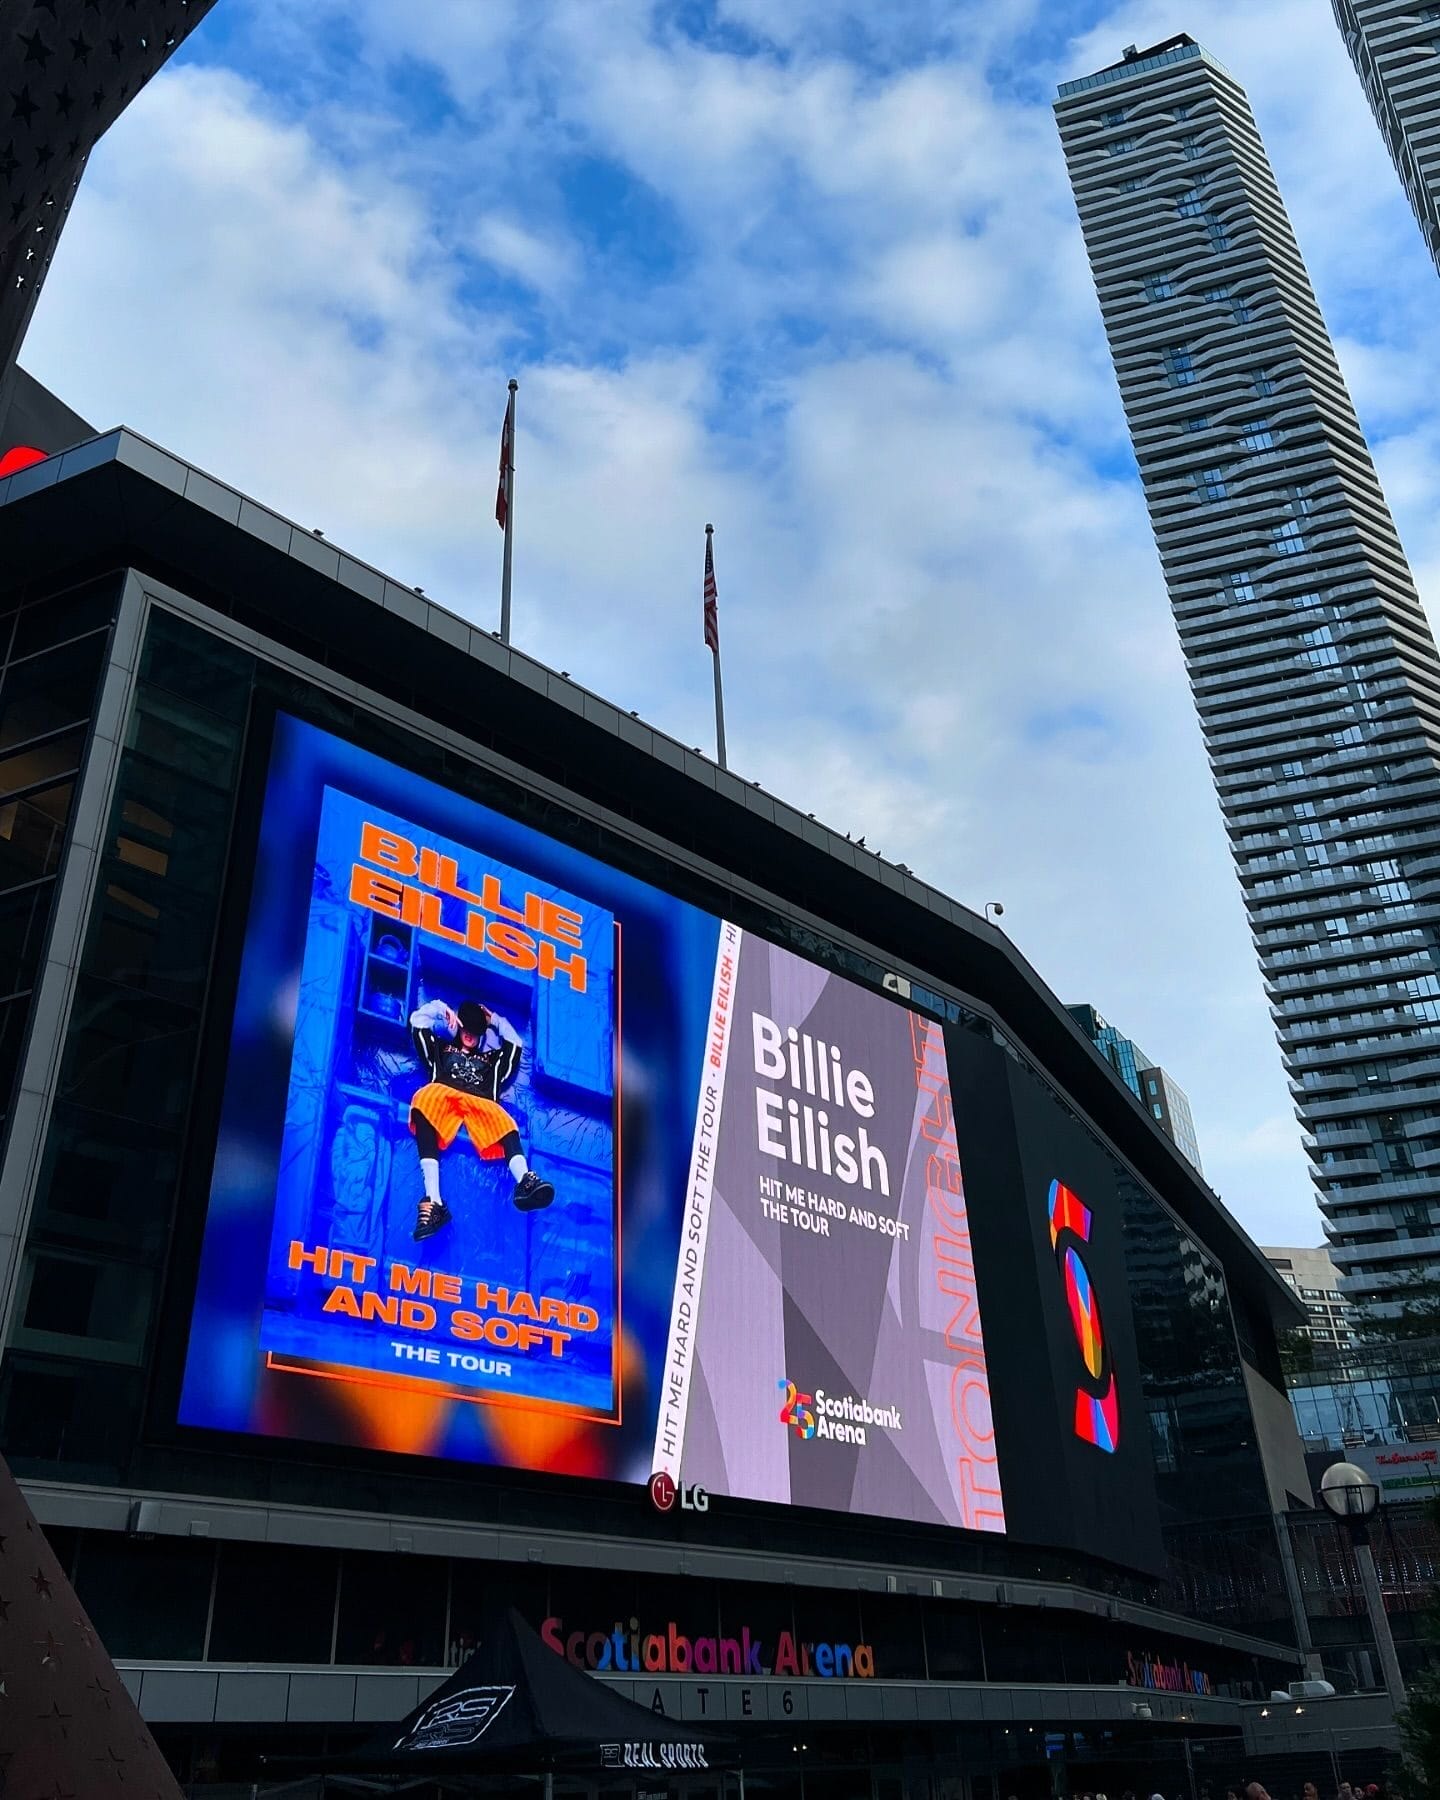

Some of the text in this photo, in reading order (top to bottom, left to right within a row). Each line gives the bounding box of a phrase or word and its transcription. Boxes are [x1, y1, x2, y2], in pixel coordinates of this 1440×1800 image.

[360, 821, 583, 949] BILLIE
[349, 863, 587, 993] EILISH
[717, 955, 733, 1009] EILISH
[710, 1015, 726, 1069] BILLIE
[752, 1012, 875, 1118] Billie
[701, 1089, 718, 1138] TOUR
[695, 1143, 711, 1184] THE
[756, 1087, 890, 1197] Eilish
[688, 1190, 705, 1244] SOFT
[760, 1175, 910, 1241] HIT ME HARD AND SOFT
[760, 1199, 830, 1237] THE TOUR
[288, 1240, 599, 1332] HIT ME HARD
[682, 1248, 698, 1297] AND
[322, 1285, 571, 1357] AND SOFT
[672, 1302, 692, 1368] HARD
[391, 1342, 512, 1377] THE TOUR
[668, 1374, 684, 1409] ME
[778, 1379, 815, 1439] 25
[815, 1389, 902, 1430] Scotiabank
[662, 1412, 678, 1456] HIT
[817, 1416, 866, 1445] Arena
[681, 1480, 709, 1512] LG
[541, 1616, 763, 1673] Scotiabank
[775, 1631, 874, 1678] Arena
[651, 1688, 793, 1715] ATE 6
[624, 1742, 661, 1768] REAL
[660, 1743, 709, 1769] SPORTS
